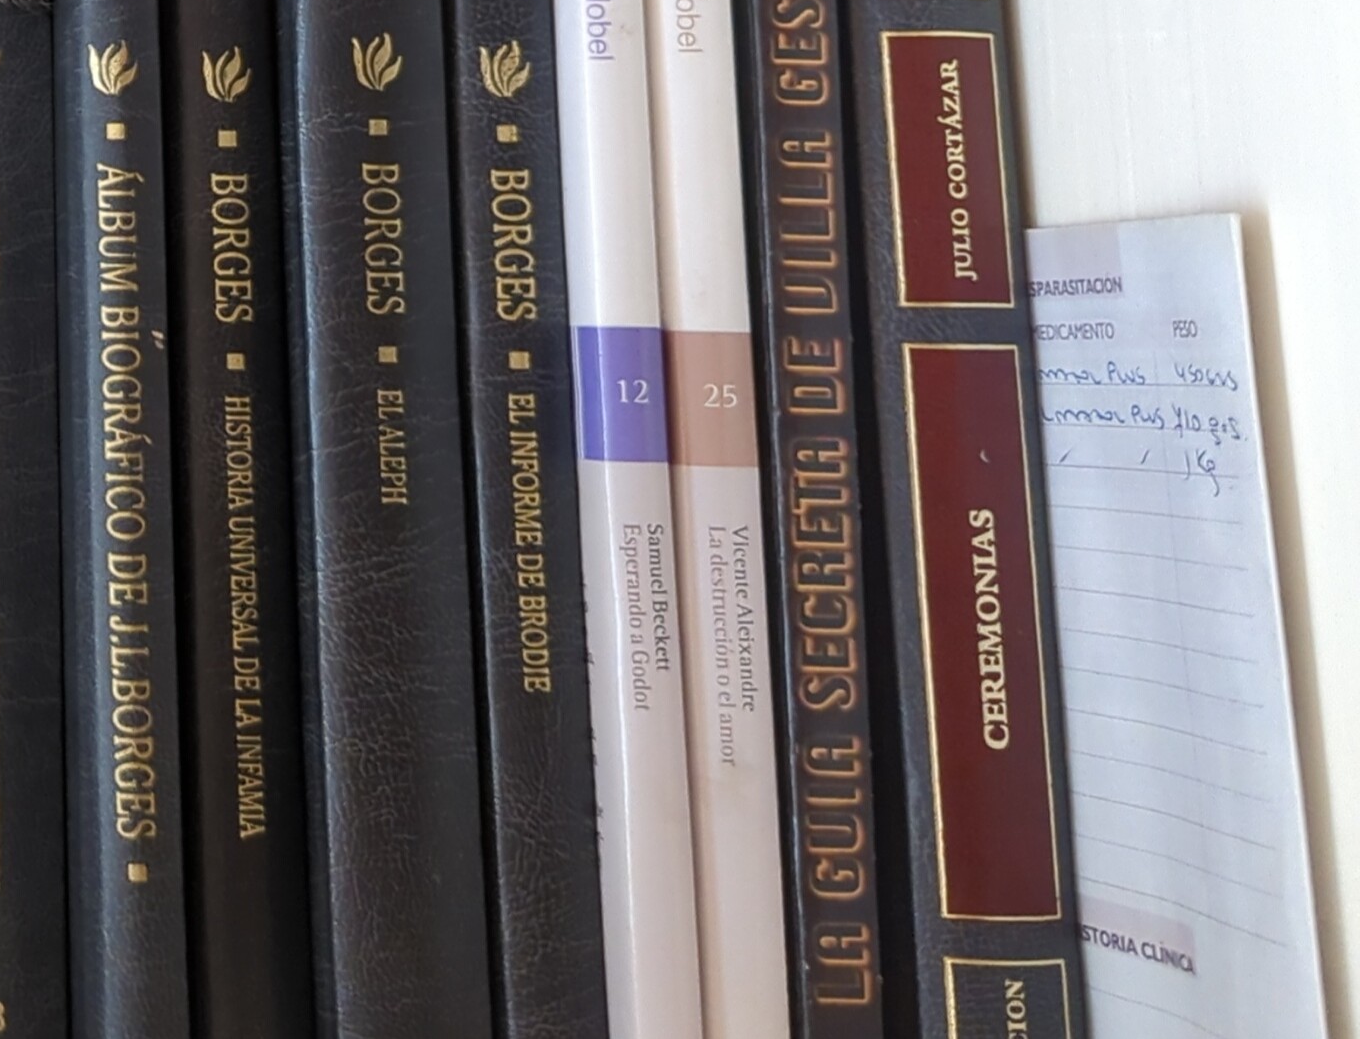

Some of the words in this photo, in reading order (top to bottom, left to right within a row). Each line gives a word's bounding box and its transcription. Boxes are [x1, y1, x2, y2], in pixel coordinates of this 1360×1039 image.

[937, 58, 967, 199] CORTÁZAR
[97, 162, 144, 292] ÁLBUM
[210, 172, 252, 323] BORGES
[361, 162, 406, 315] BORGES
[490, 168, 538, 322] BORGES
[951, 207, 978, 282] JULIO
[1172, 320, 1198, 338] PESO
[376, 388, 405, 420] EL
[507, 393, 536, 425] EL
[616, 379, 649, 403] 12
[703, 383, 737, 408] 25
[782, 336, 845, 414] DE
[100, 305, 151, 541] BIOGRÁFICO
[224, 395, 254, 511] HISTORIA
[378, 424, 408, 505] ALEPH
[509, 430, 544, 547] INFORME
[516, 553, 546, 588] DE
[647, 523, 668, 595] Samuel
[708, 525, 726, 549] La
[732, 525, 750, 600] Vicente
[790, 436, 858, 710] SECRETA
[107, 552, 148, 606] DE
[227, 516, 259, 651] UNIVERSAL
[619, 524, 646, 629] Esperando
[710, 554, 732, 673] destrucción
[518, 594, 552, 693] BRODIE
[630, 634, 644, 645] a
[653, 599, 671, 671] Beckett
[737, 604, 759, 712] Aleixandre
[969, 508, 1010, 750] CEREMONIAS
[233, 656, 261, 692] DE
[631, 650, 652, 711] Godot
[716, 674, 730, 686] o
[718, 691, 736, 709] el
[234, 698, 262, 729] LA
[719, 713, 736, 767] amor
[236, 734, 266, 840] INFAMIA
[813, 922, 873, 1004] LA
